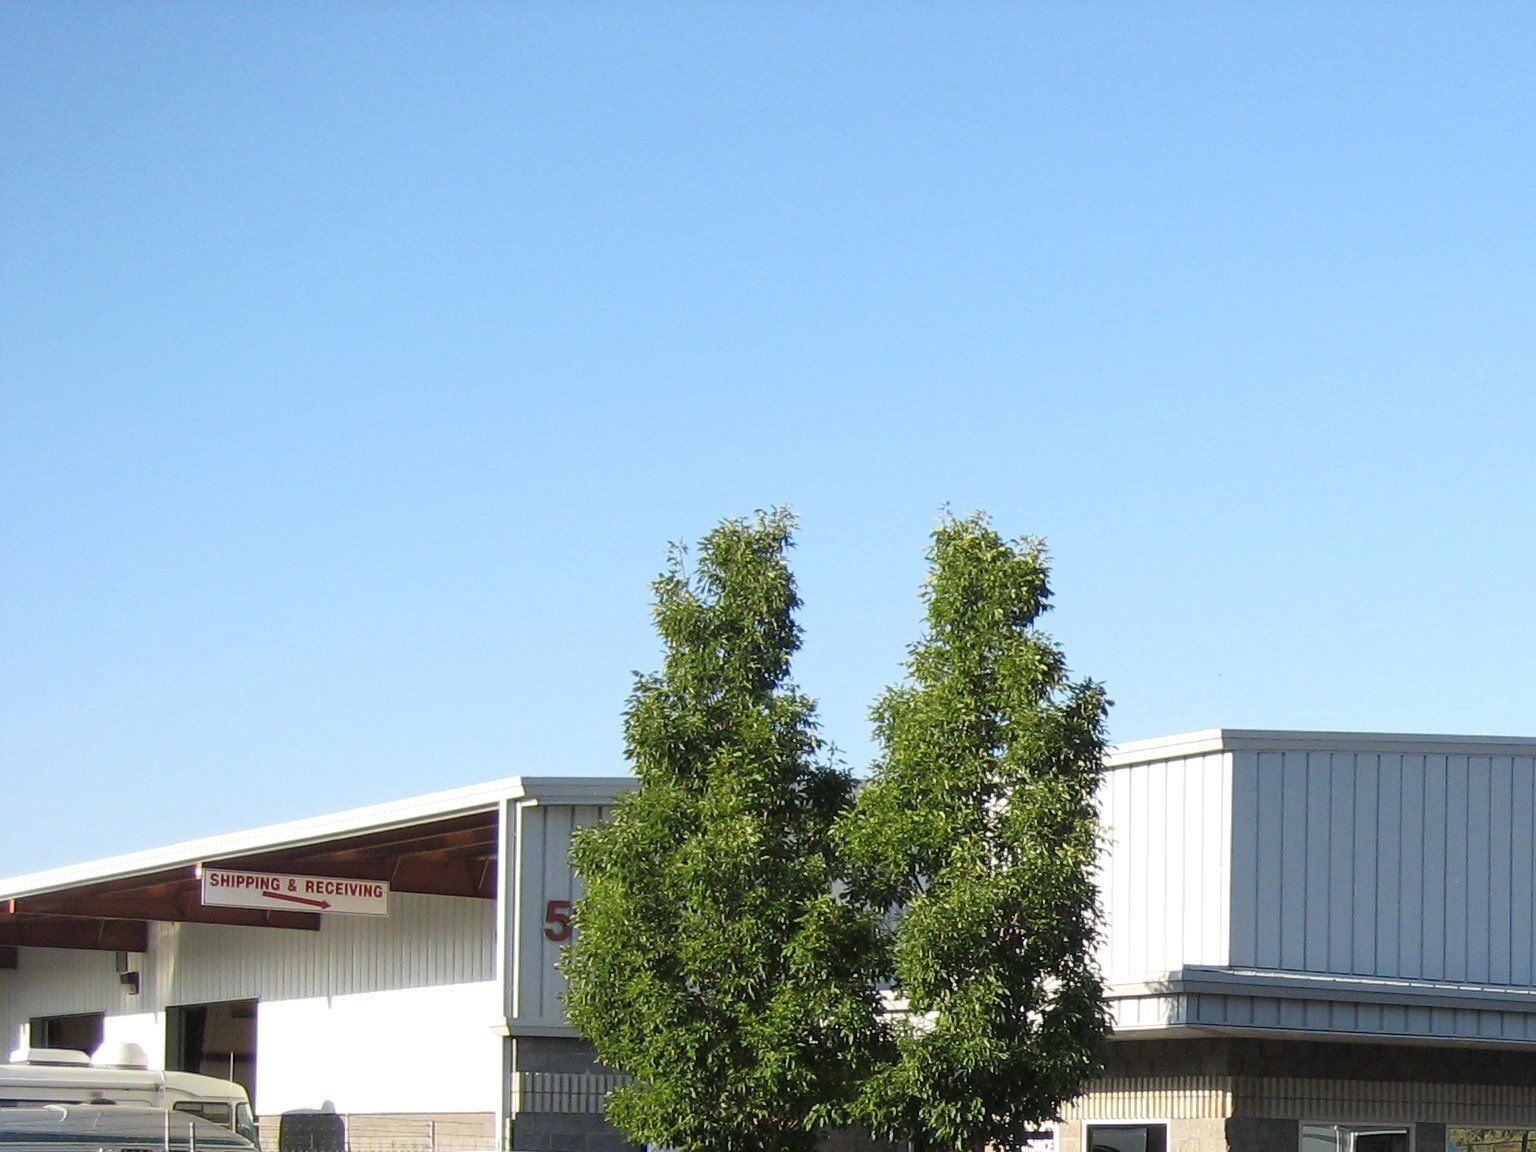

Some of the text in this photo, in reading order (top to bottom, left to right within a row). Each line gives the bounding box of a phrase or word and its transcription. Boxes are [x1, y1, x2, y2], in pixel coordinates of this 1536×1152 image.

[210, 873, 383, 898] SHIPPING & RECEIVING
